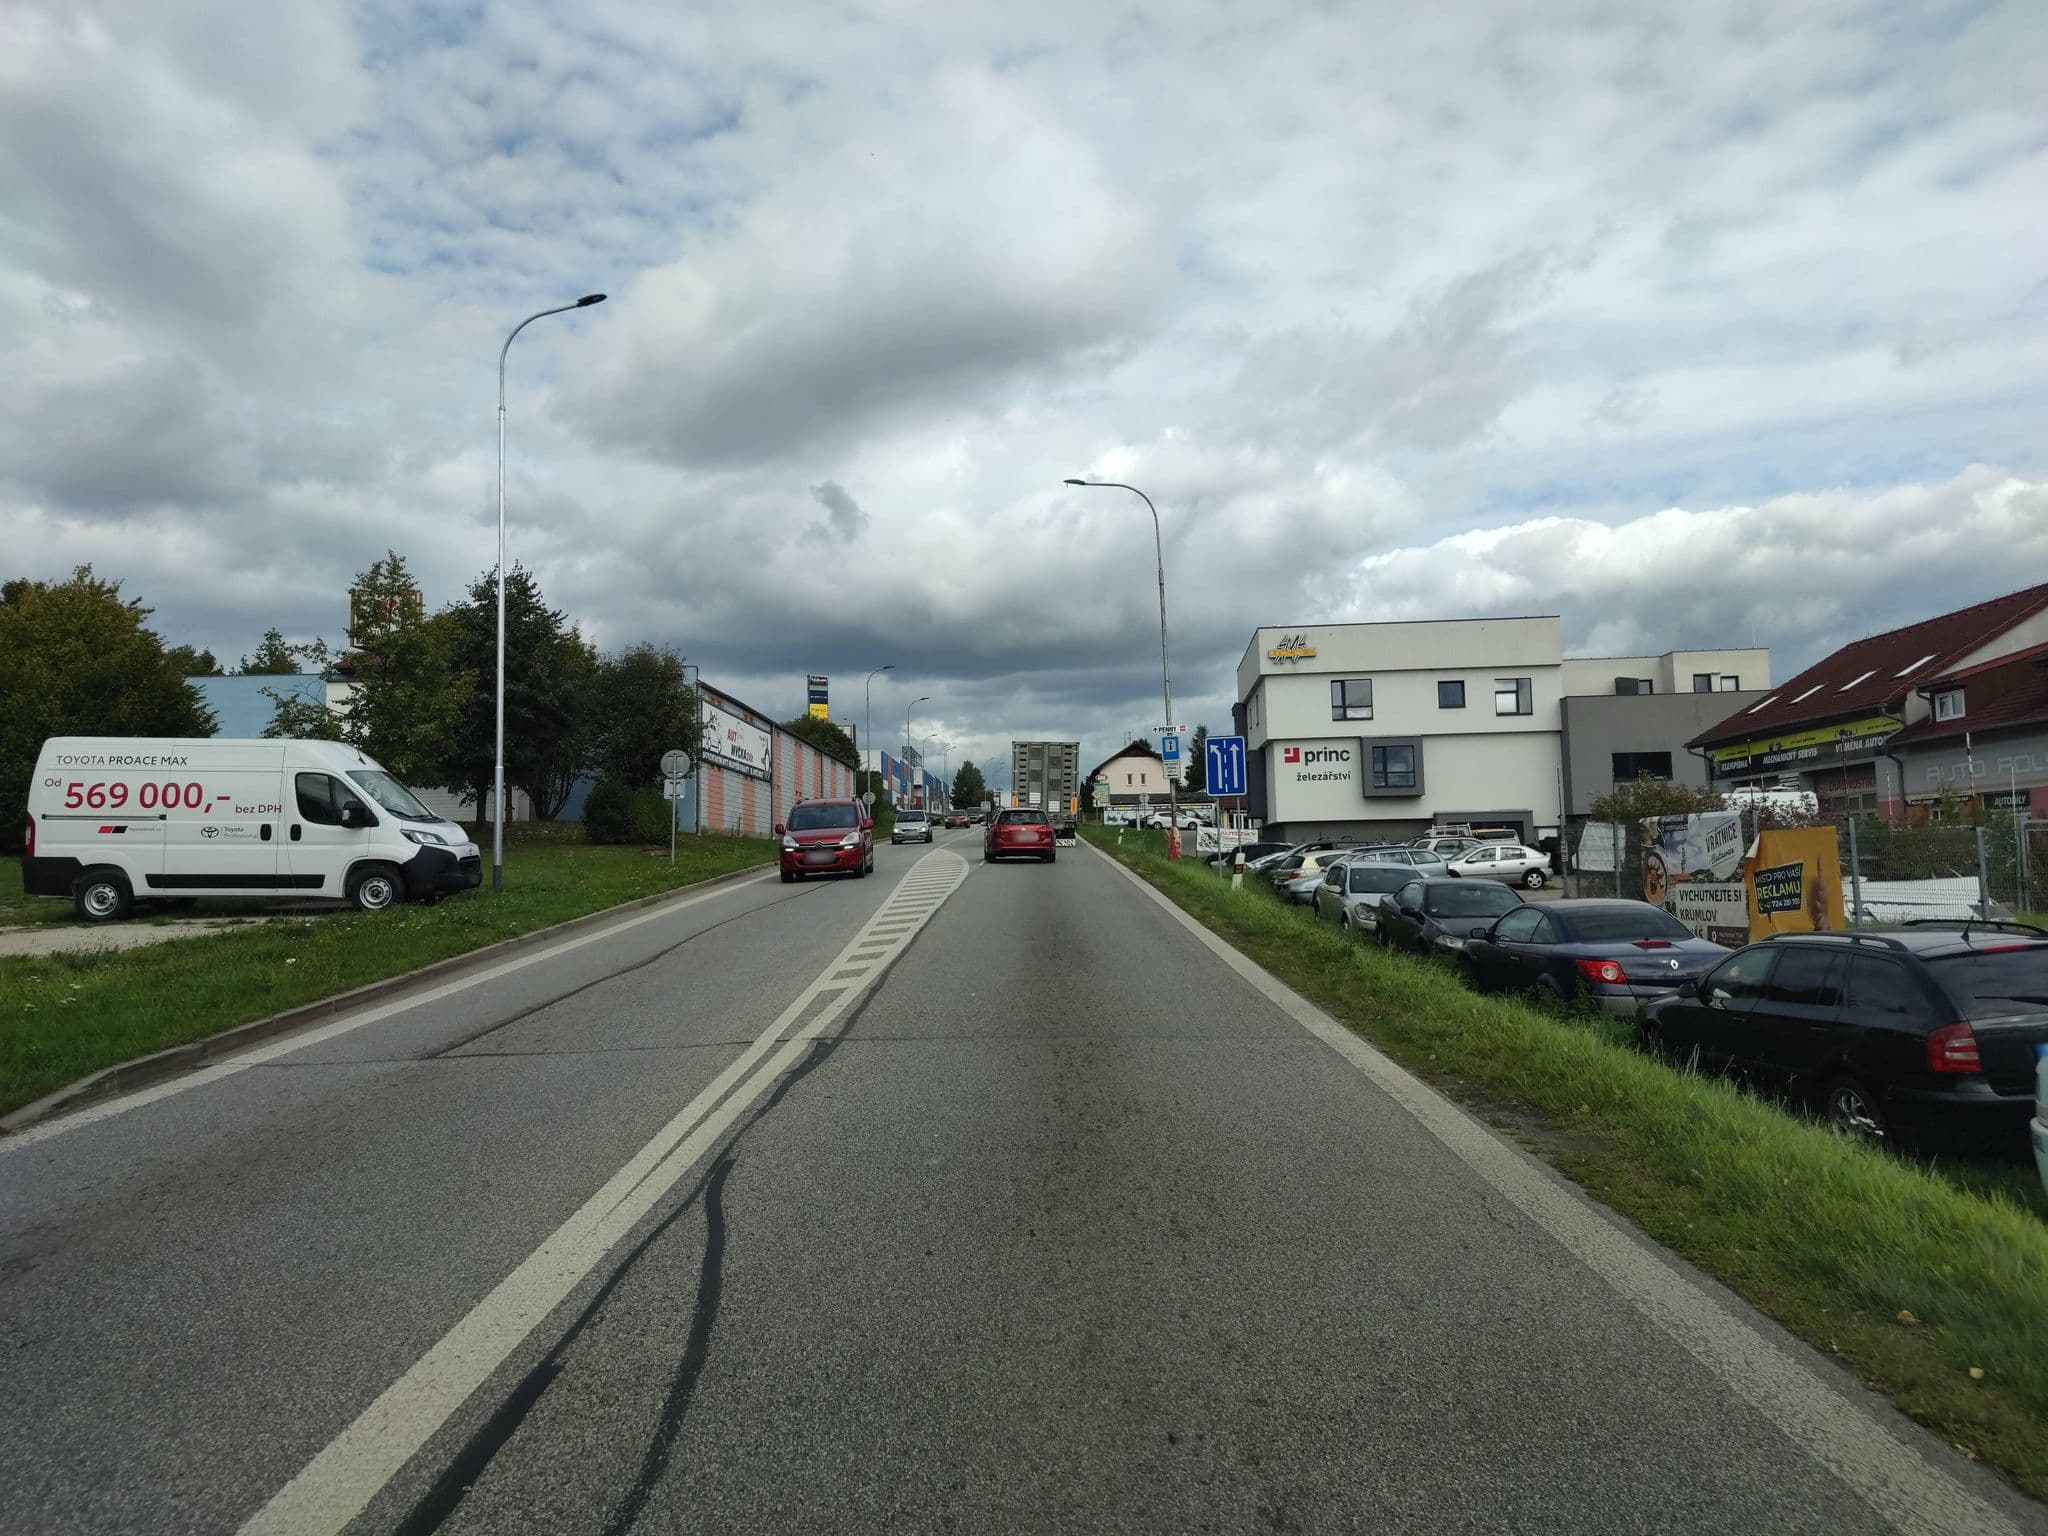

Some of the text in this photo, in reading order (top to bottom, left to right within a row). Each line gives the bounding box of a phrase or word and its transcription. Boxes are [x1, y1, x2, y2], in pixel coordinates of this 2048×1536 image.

[1304, 746, 1351, 766] princ
[1798, 746, 1818, 760] SERVIS
[56, 755, 188, 766] TOYOTA PROACE MAX
[1296, 770, 1352, 782] železářství
[44, 778, 231, 813] Od 569 000,-
[235, 804, 282, 814] bez DPH
[1705, 822, 1738, 853] VRÁTNICE
[1773, 871, 1786, 880] PRO
[1679, 889, 1742, 902] VYCHUTNEJTE SI
[1756, 881, 1801, 900] REKLAMU
[1679, 908, 1717, 921] KRUMLOV
